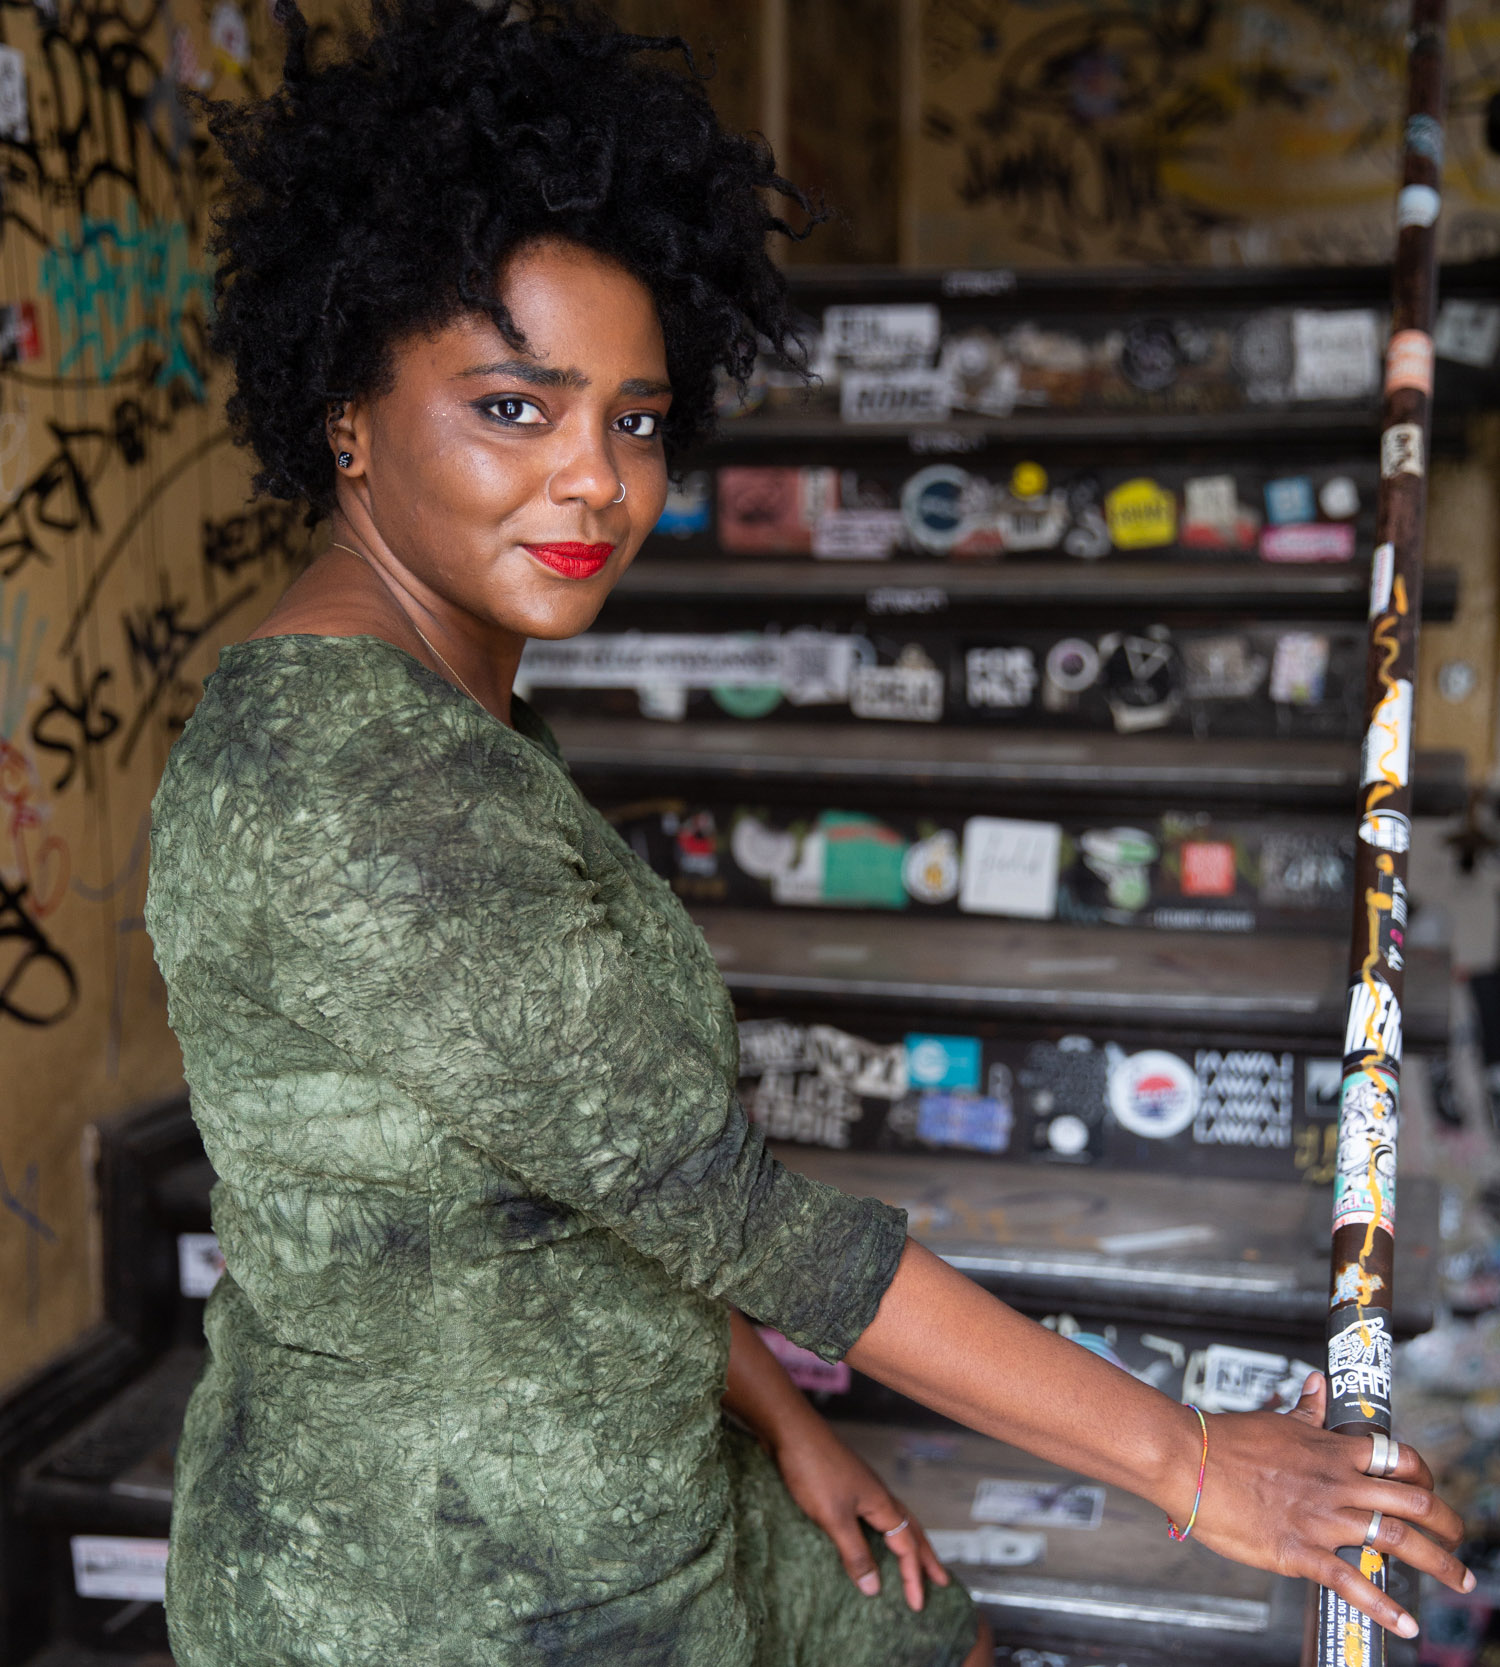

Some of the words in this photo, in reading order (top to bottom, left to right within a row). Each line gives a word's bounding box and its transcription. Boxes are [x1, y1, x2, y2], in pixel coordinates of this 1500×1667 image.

[1338, 1598, 1347, 1614] OUT
[1327, 1622, 1335, 1638] THE
[1337, 1615, 1346, 1640] PHASE
[1326, 1638, 1334, 1647] IN
[1361, 1628, 1371, 1644] ARE
[1326, 1647, 1334, 1663] ARE
[1337, 1647, 1345, 1655] IS
[1336, 1656, 1345, 1667] AN
